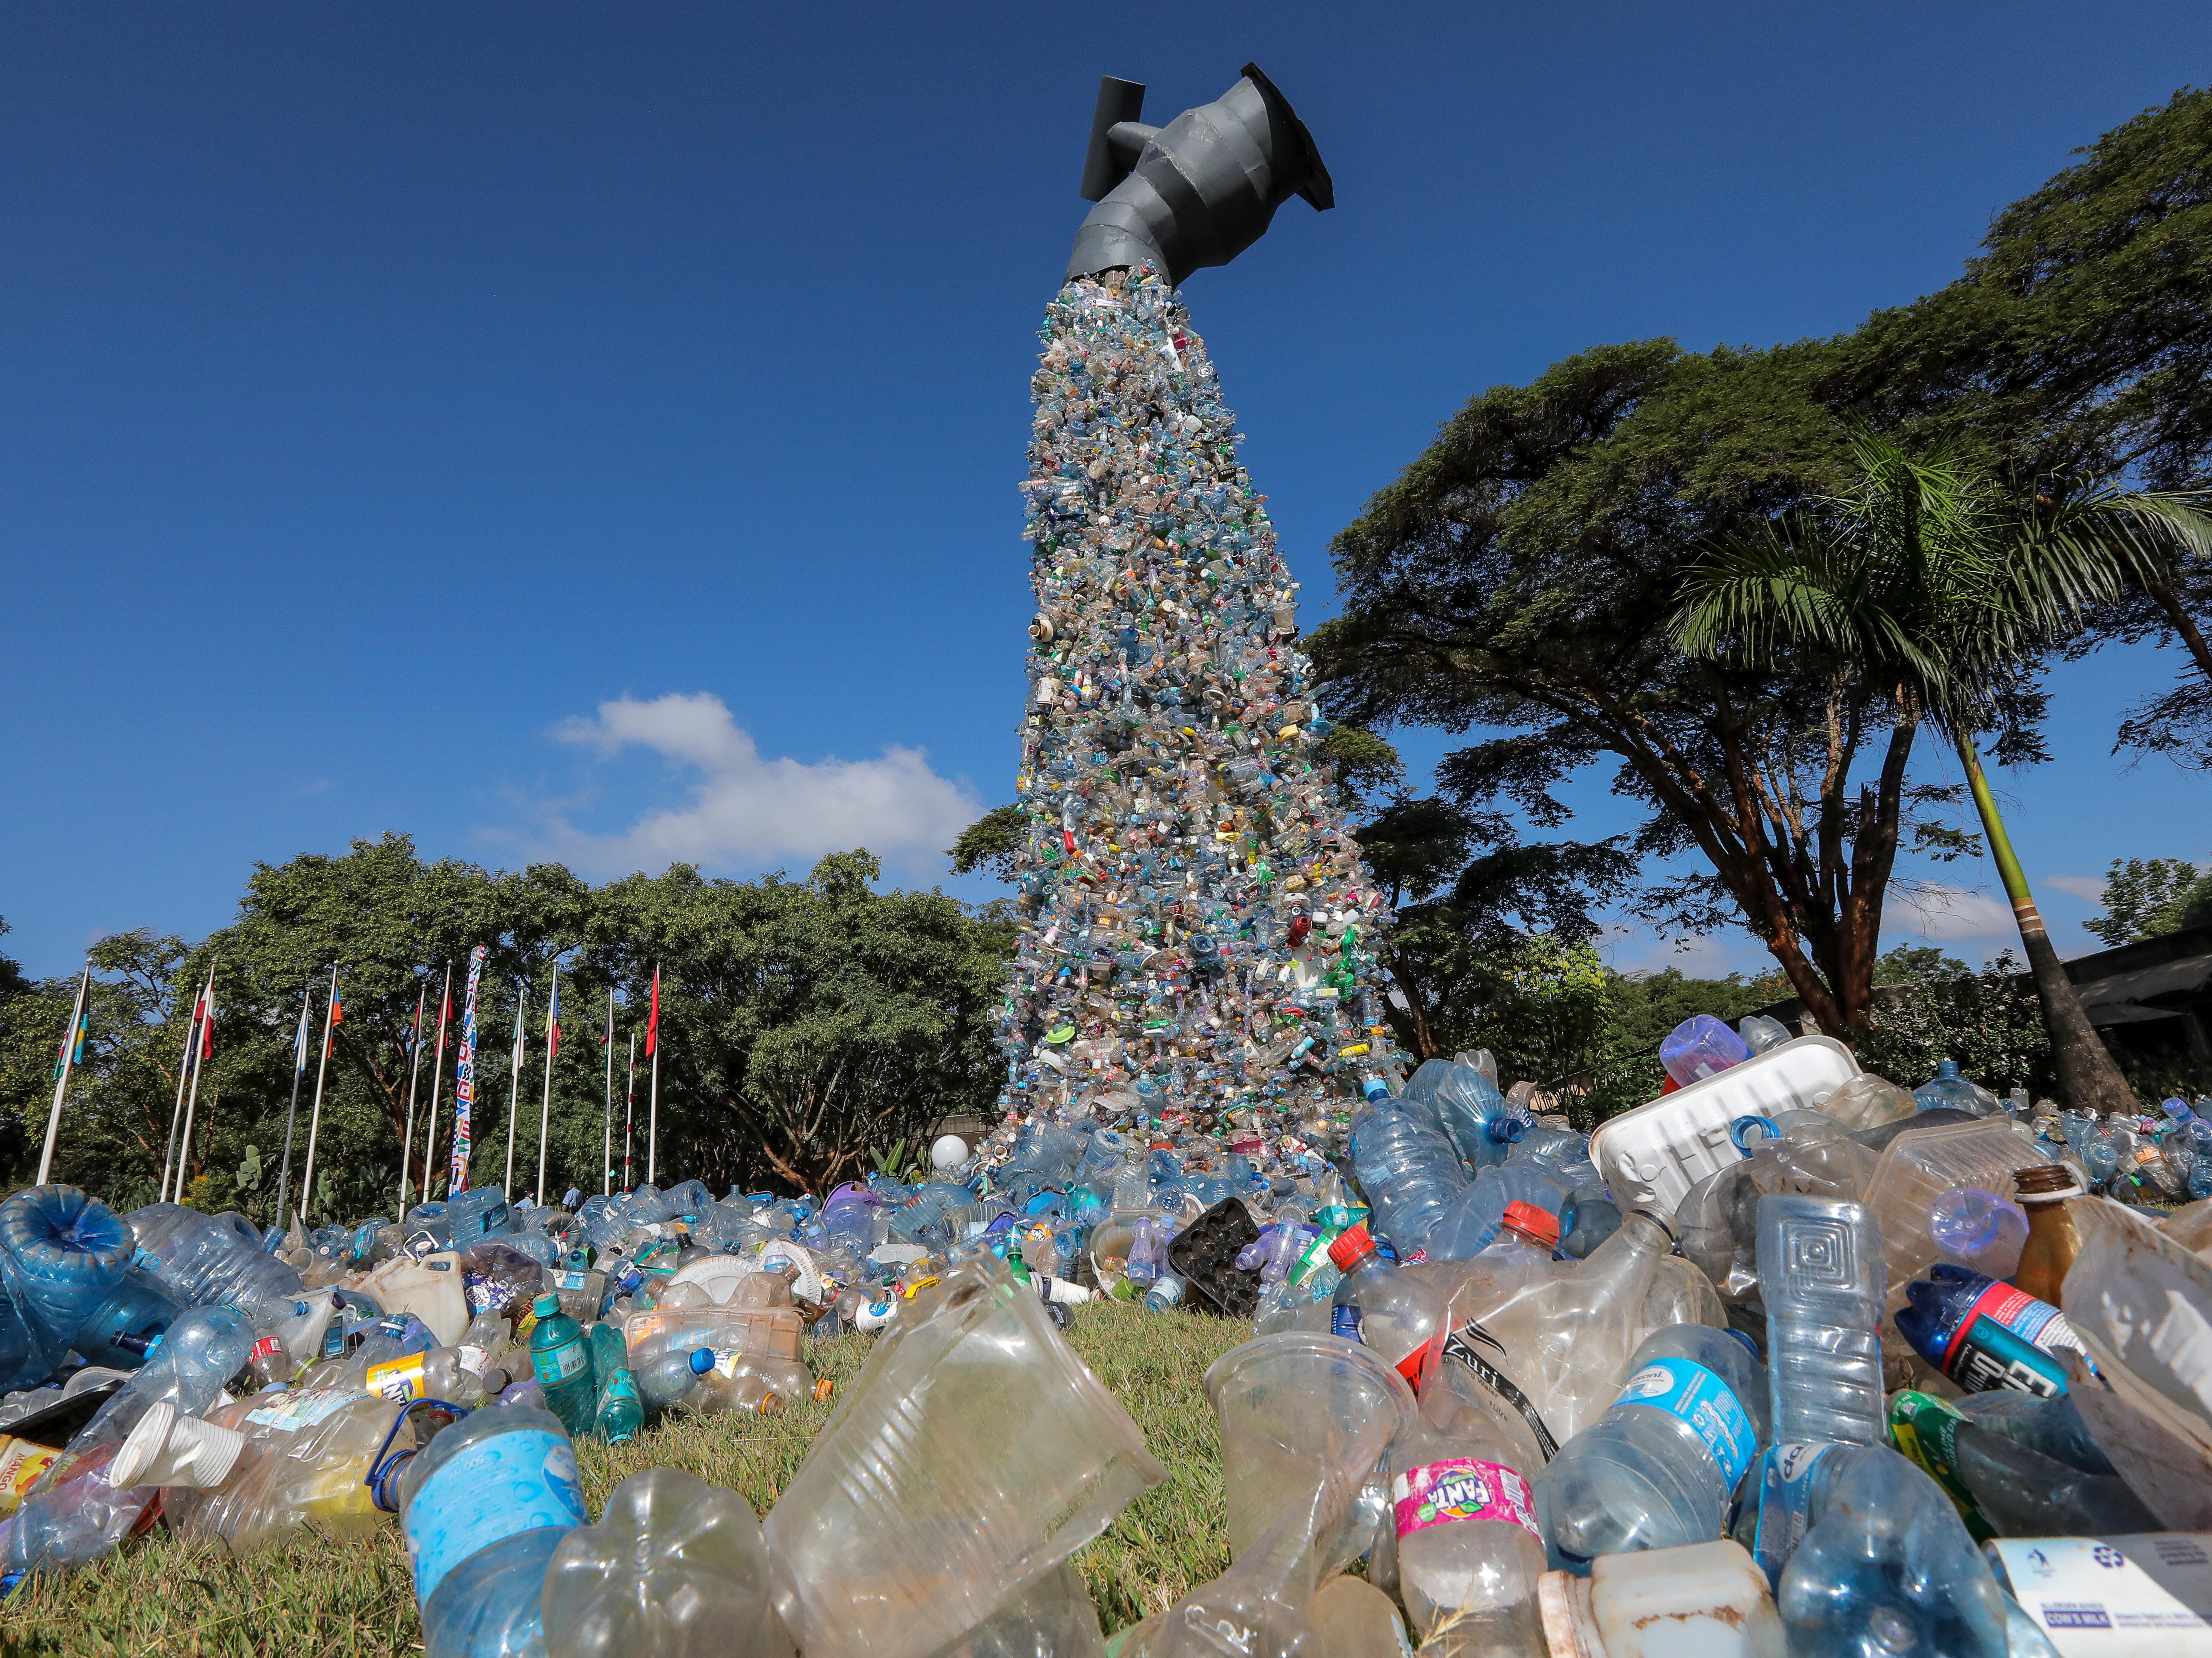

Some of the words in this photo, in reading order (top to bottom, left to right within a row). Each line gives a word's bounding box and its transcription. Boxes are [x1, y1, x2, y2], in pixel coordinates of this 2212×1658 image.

[1444, 1357, 1475, 1380] Drinking
[1478, 1377, 1498, 1398] Water
[1446, 1336, 1499, 1391] Zuri
[0, 1453, 25, 1491] MANGO
[1426, 1478, 1492, 1510] FANTA
[2046, 1612, 2082, 1625] COW'S
